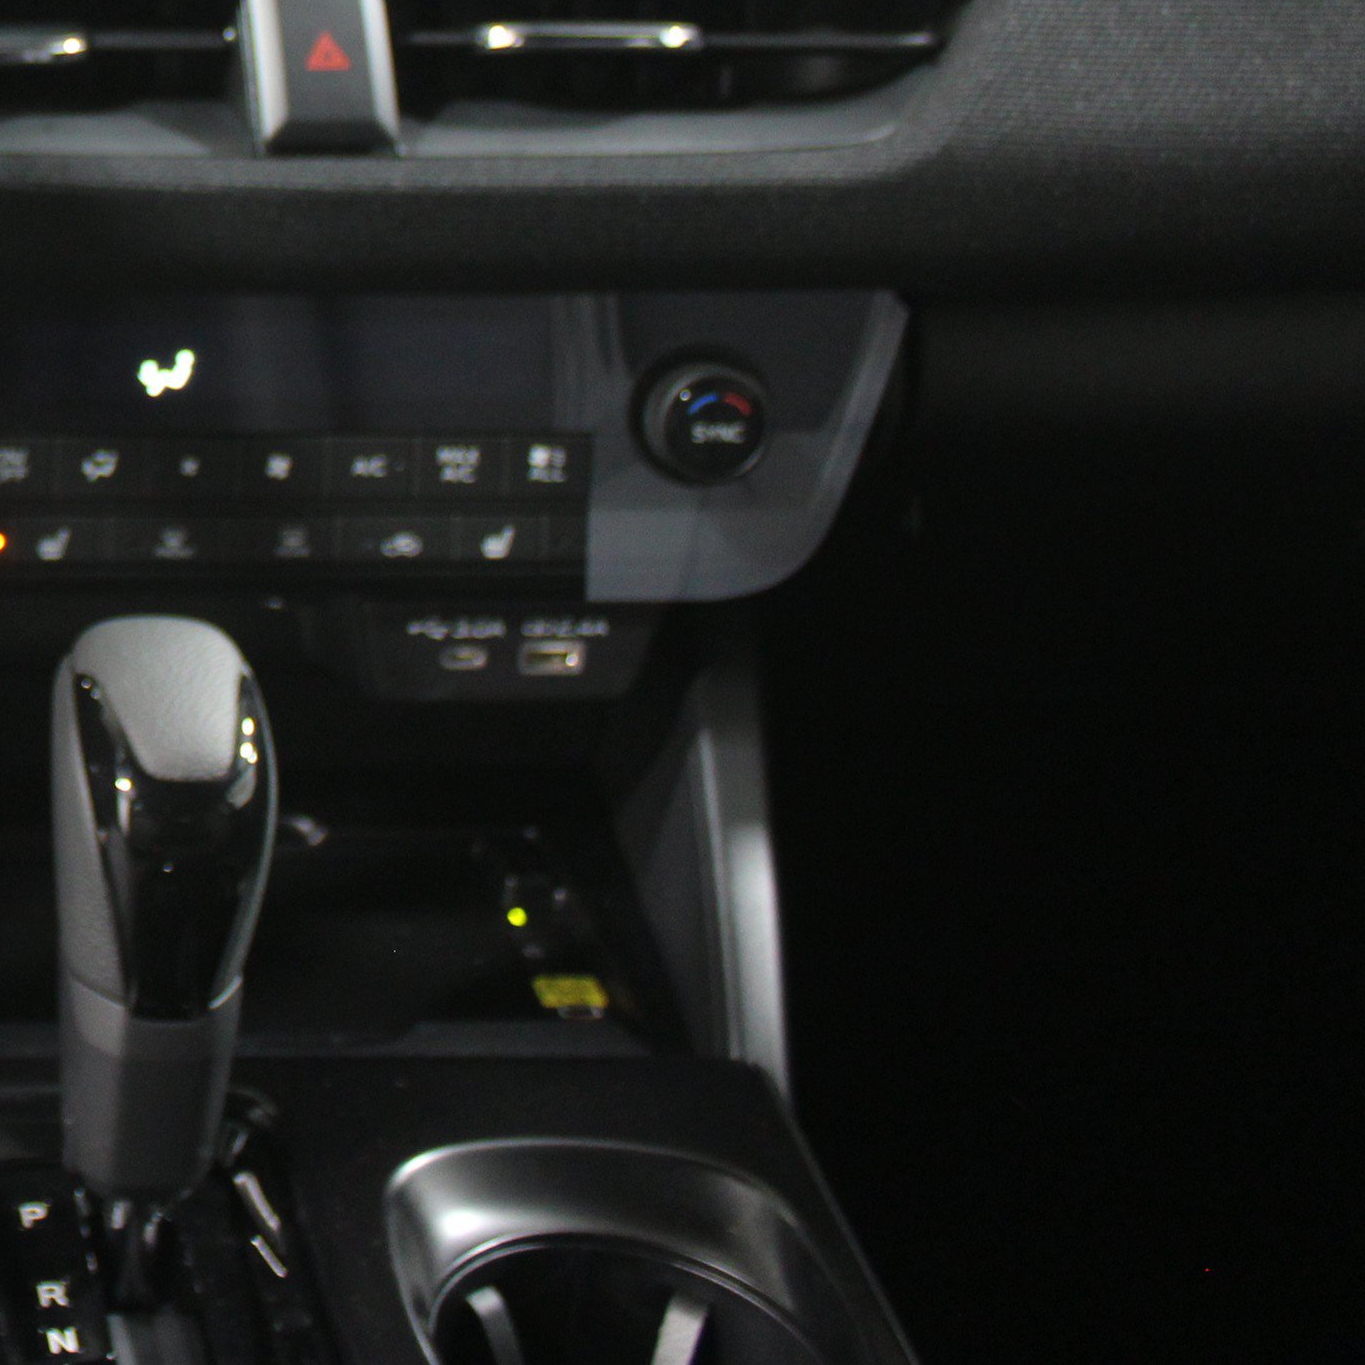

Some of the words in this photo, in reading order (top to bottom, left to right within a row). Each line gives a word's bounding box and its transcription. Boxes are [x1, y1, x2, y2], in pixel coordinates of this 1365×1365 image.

[17, 1201, 49, 1230] P
[36, 1280, 70, 1309] R
[45, 1325, 81, 1355] N
